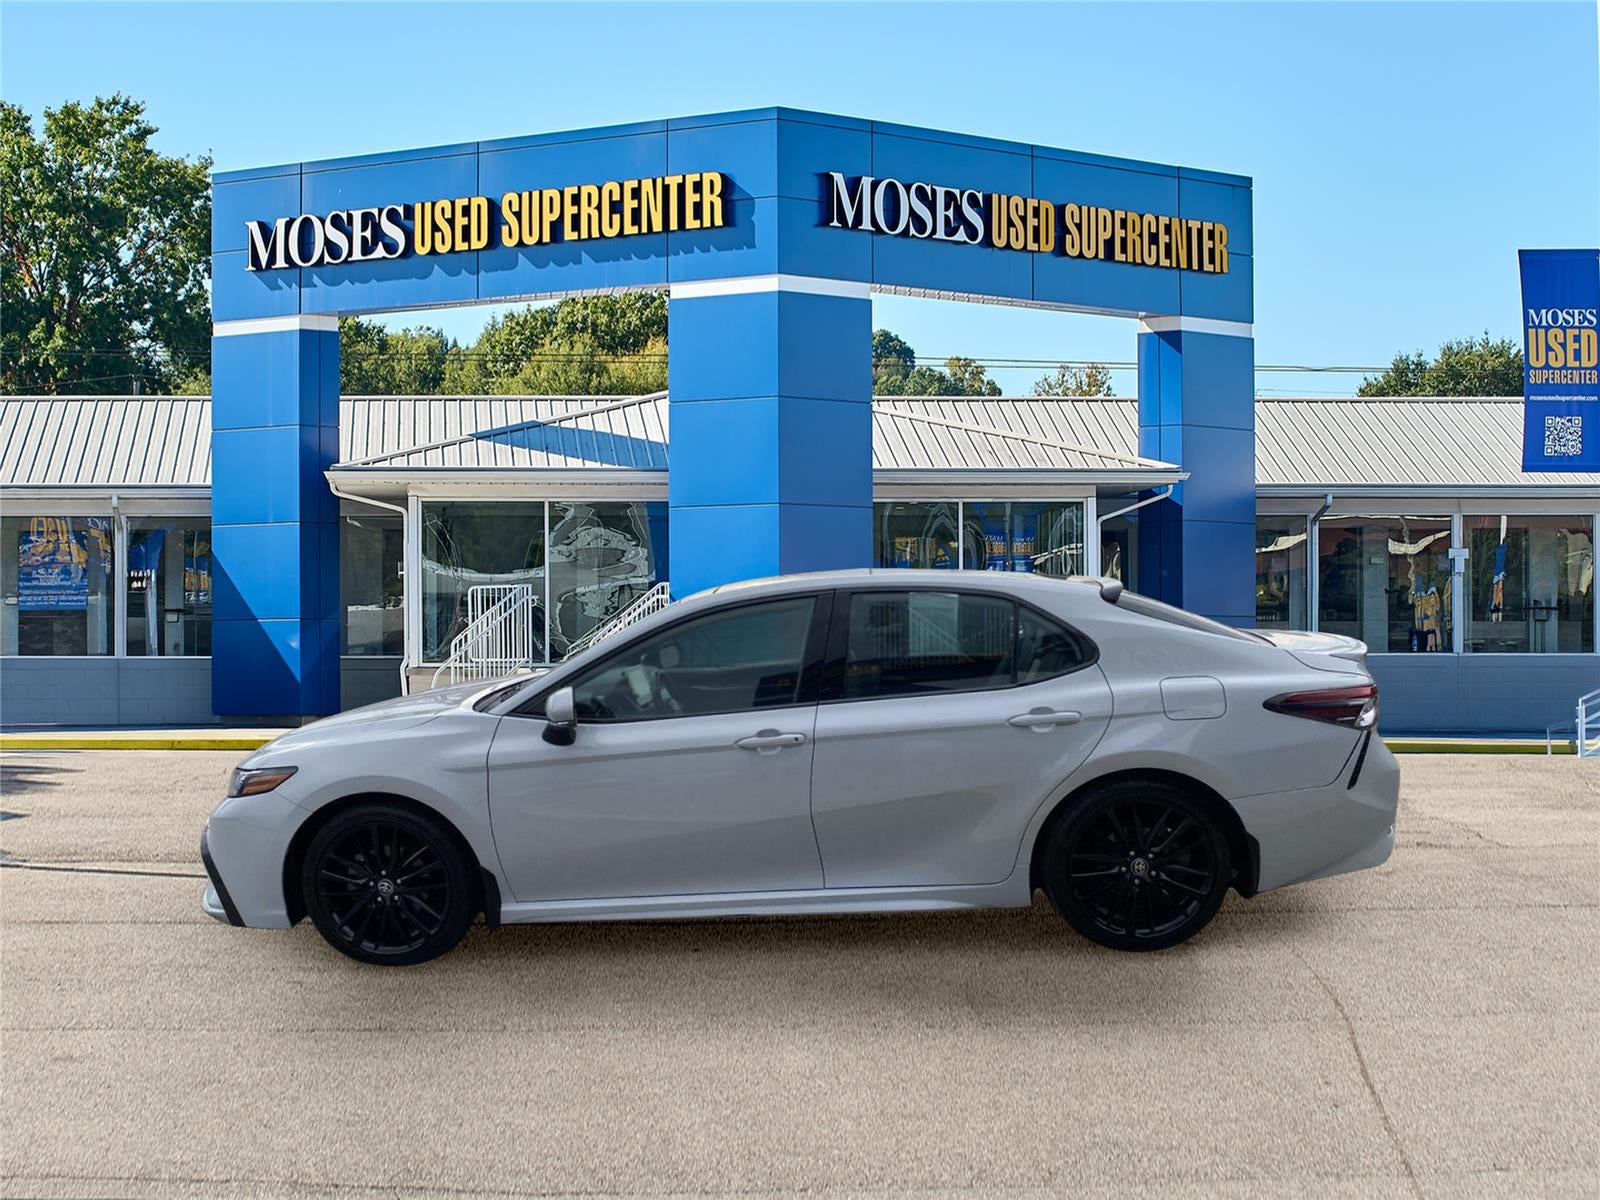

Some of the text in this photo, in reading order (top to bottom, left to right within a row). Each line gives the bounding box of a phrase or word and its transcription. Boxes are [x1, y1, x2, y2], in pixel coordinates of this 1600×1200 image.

[244, 171, 724, 272] MOSES USED SUPERCENTER
[828, 171, 1230, 274] MOSES USED SUPERCENTER
[1527, 308, 1597, 328] MOSES
[1528, 328, 1598, 368] USED
[1529, 370, 1598, 384] SUPERCENTER
